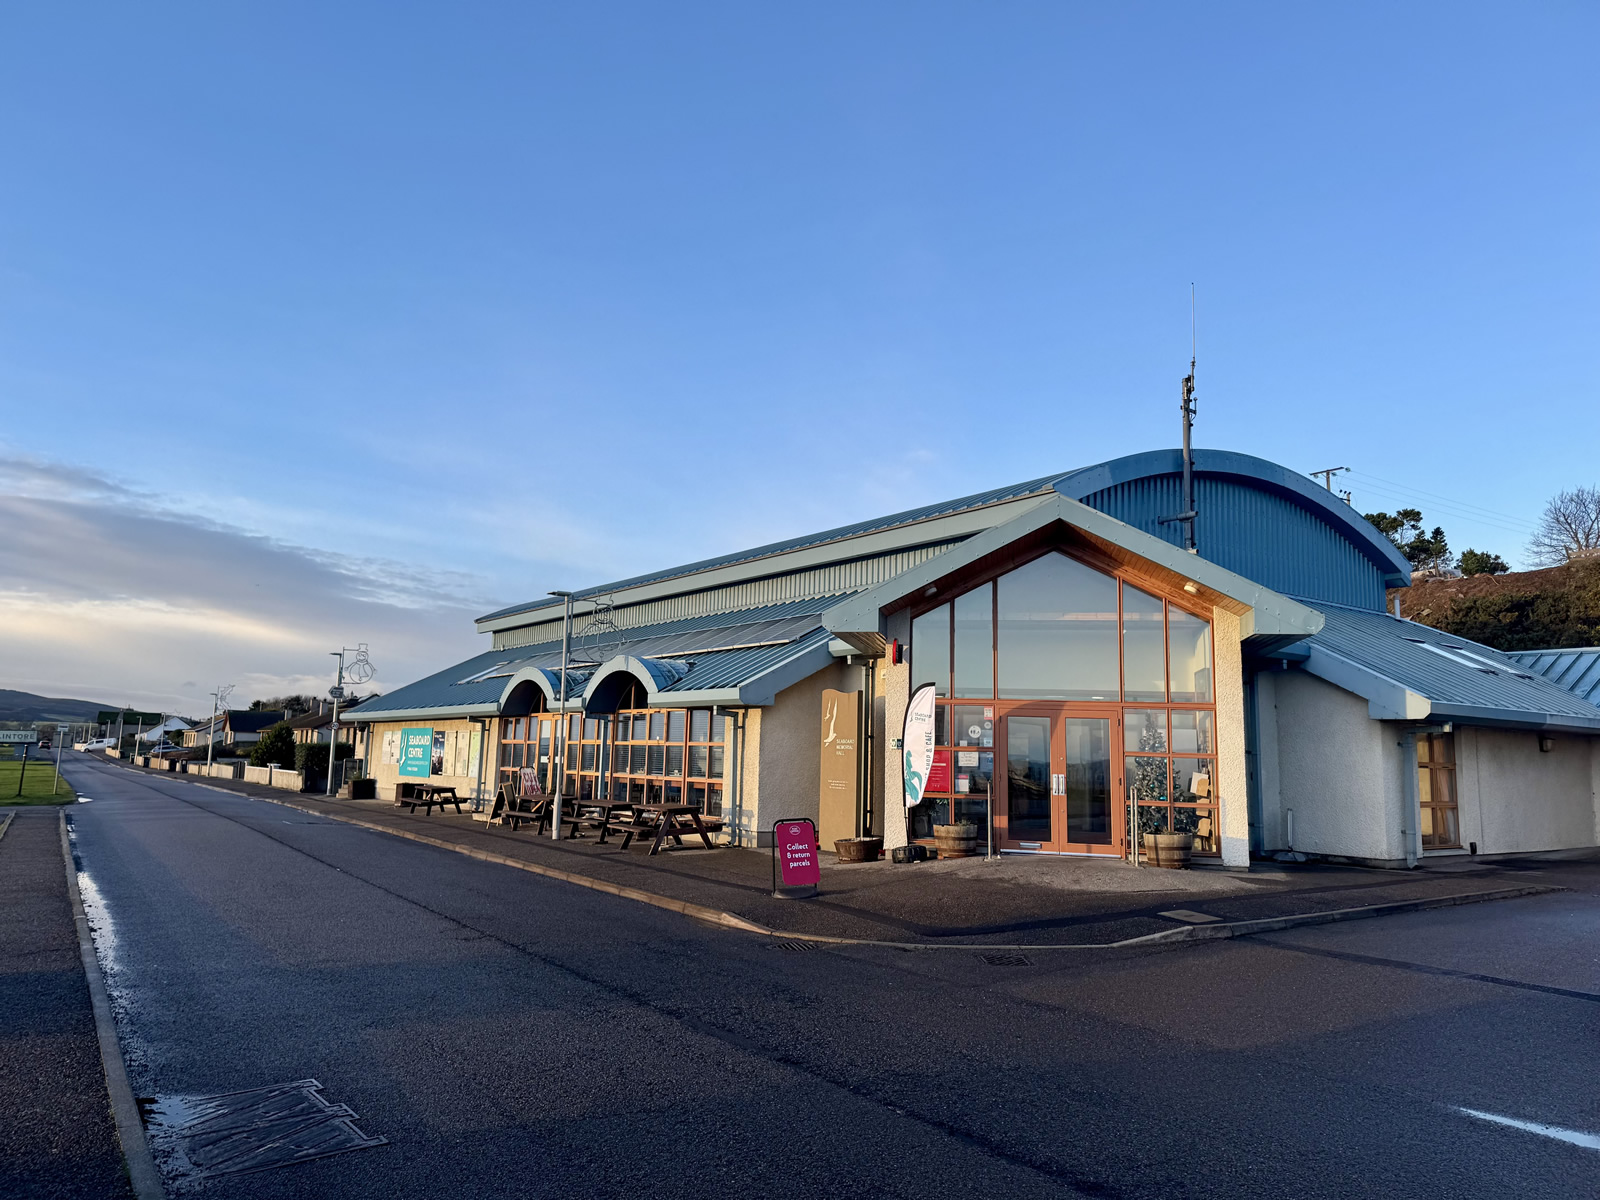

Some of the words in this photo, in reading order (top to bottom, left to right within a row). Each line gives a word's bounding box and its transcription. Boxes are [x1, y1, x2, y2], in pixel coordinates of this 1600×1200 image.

[409, 735, 430, 745] SEABOARD
[408, 748, 423, 757] CENTRE
[790, 859, 810, 868] parcels
